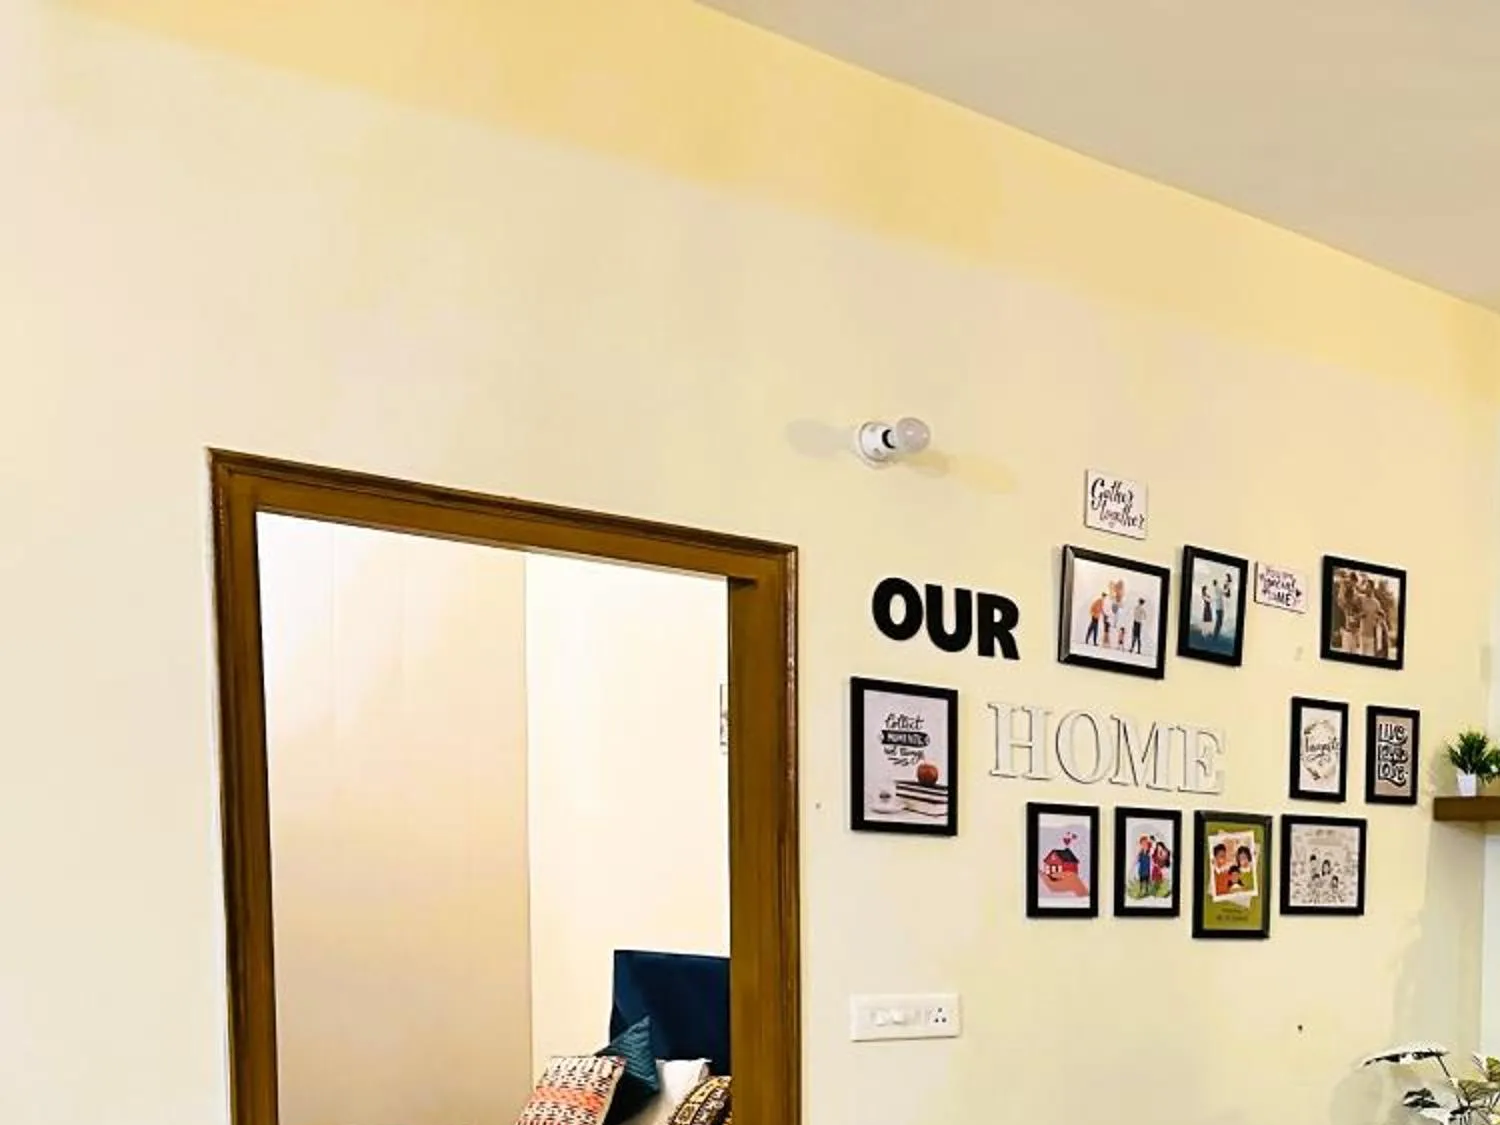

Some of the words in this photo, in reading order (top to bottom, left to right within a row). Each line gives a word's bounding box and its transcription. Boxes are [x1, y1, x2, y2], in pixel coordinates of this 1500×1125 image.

[1091, 477, 1134, 510] Gather
[1100, 499, 1145, 529] together
[872, 577, 1020, 660] OUR
[986, 702, 1225, 794] HOME
